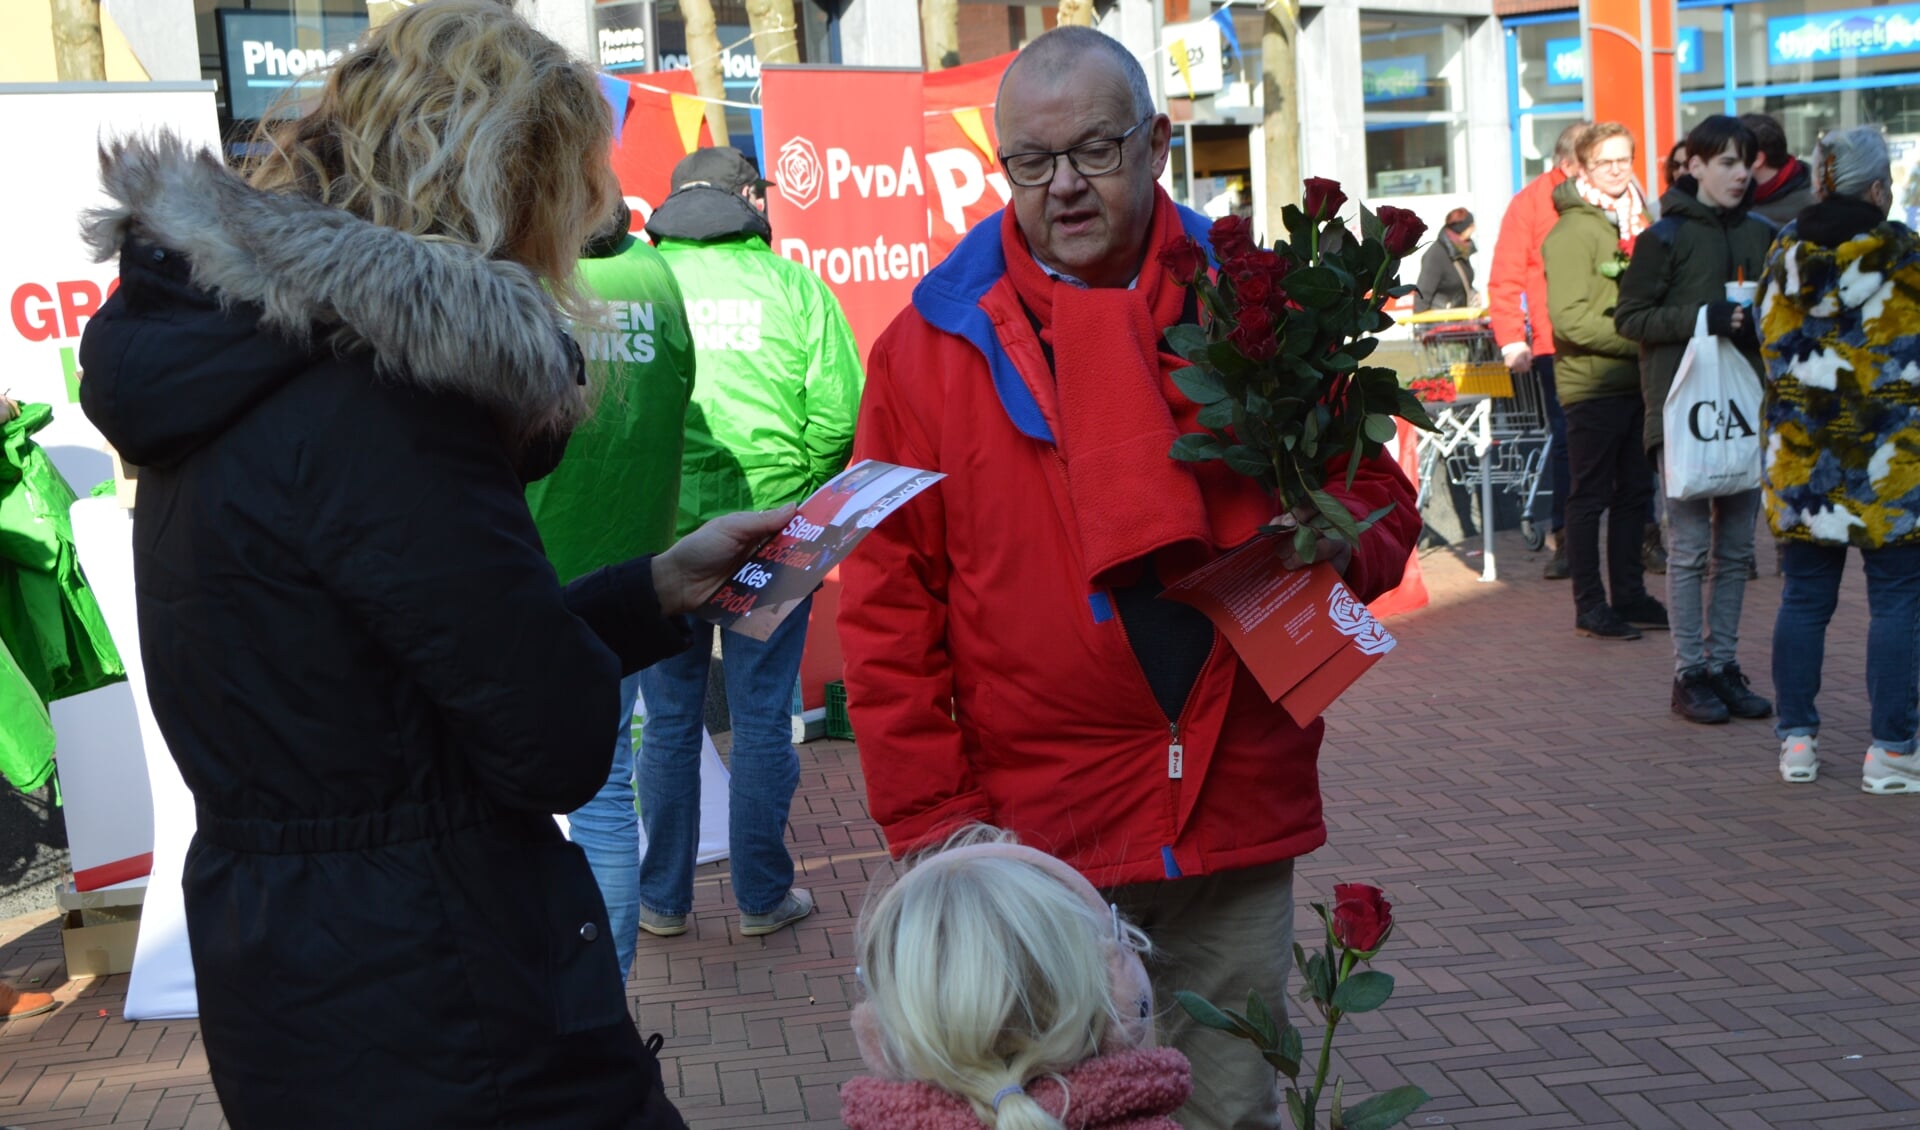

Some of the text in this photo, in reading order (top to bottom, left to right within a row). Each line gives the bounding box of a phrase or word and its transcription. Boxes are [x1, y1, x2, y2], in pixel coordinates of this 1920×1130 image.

[780, 235, 930, 285] Dronten
[1688, 398, 1757, 442] C&A
[782, 514, 825, 542] Stem
[732, 561, 773, 589] Kies
